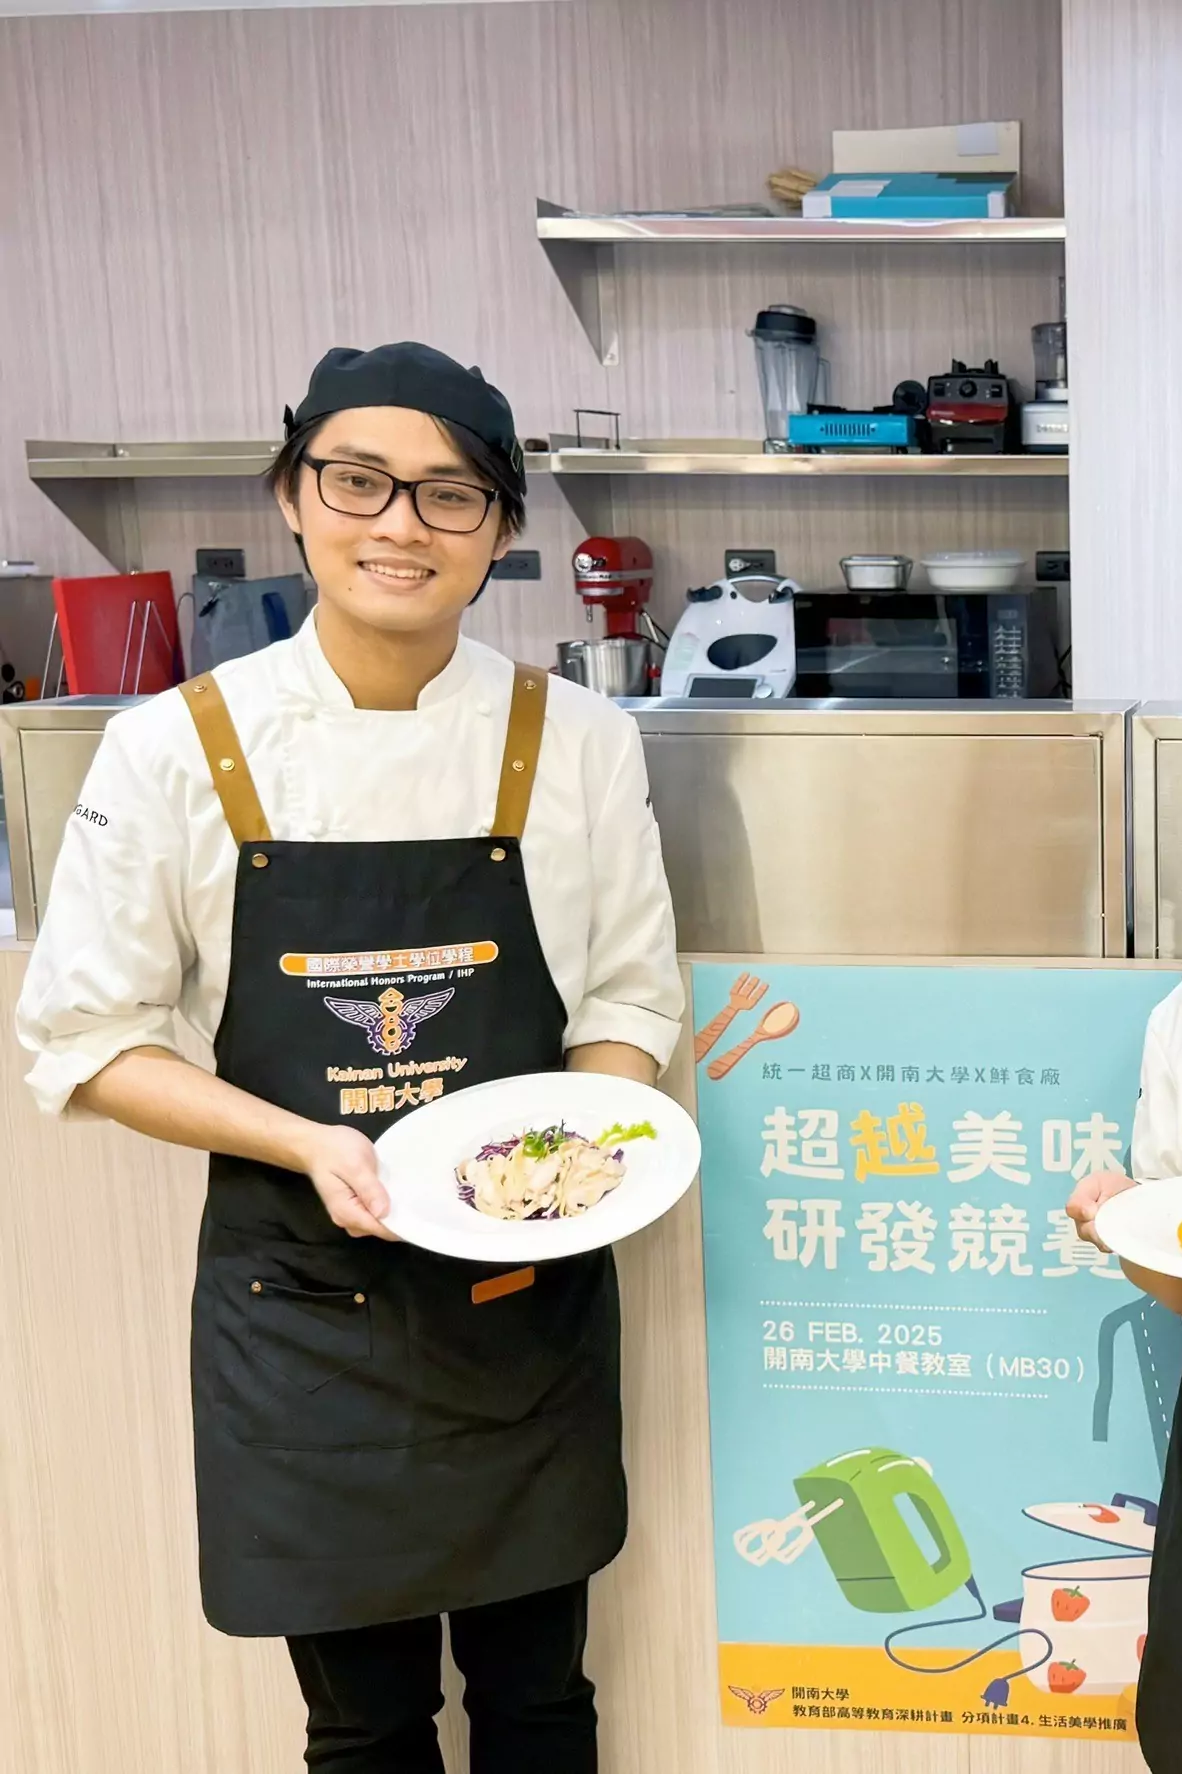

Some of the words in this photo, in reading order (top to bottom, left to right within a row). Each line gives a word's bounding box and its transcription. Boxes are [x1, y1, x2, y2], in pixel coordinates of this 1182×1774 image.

[73, 804, 109, 827] GARD
[306, 946, 475, 974] 國際榮譽學士學位學程
[307, 978, 368, 989] International
[371, 975, 405, 987] Honors
[407, 972, 446, 985] Program
[457, 967, 475, 979] IHP
[326, 1065, 384, 1083] Kainan
[387, 1055, 469, 1077] University
[761, 1061, 1062, 1087] 統一超商X開南大學X鮮食廠
[339, 1077, 445, 1116] 開南大學
[759, 1102, 1126, 1186] 超越美味
[762, 1320, 795, 1342] 26
[808, 1321, 864, 1345] FEB.
[878, 1323, 943, 1347] 2025
[791, 1686, 850, 1701] 開南大學
[792, 1704, 953, 1724] 教育部高等教育深耕計畫
